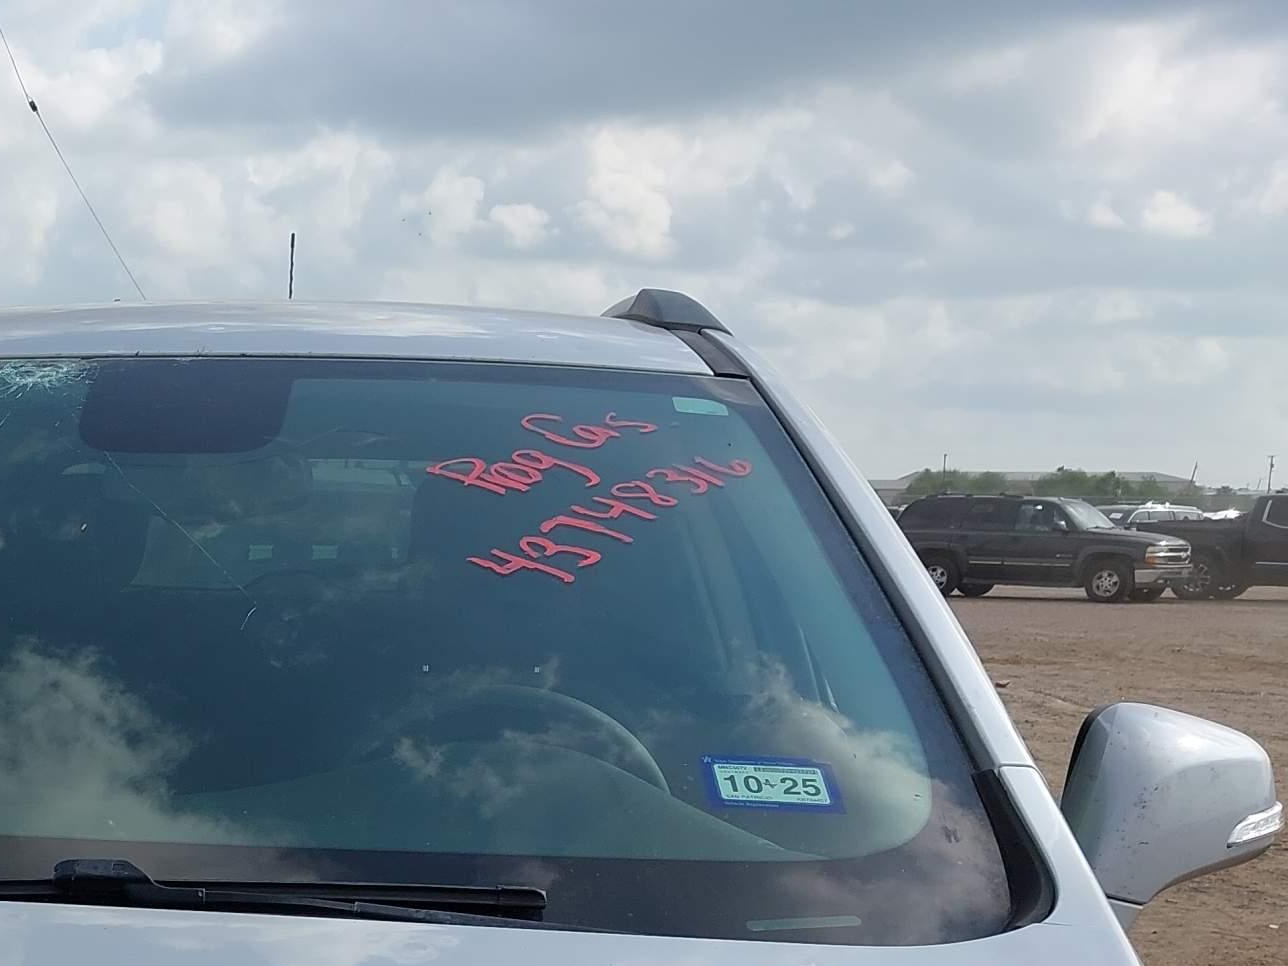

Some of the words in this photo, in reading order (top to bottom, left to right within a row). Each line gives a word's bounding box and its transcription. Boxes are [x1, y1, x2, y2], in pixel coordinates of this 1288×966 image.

[466, 455, 754, 584] 43748316
[723, 774, 764, 794] 10
[779, 776, 822, 797] 25
